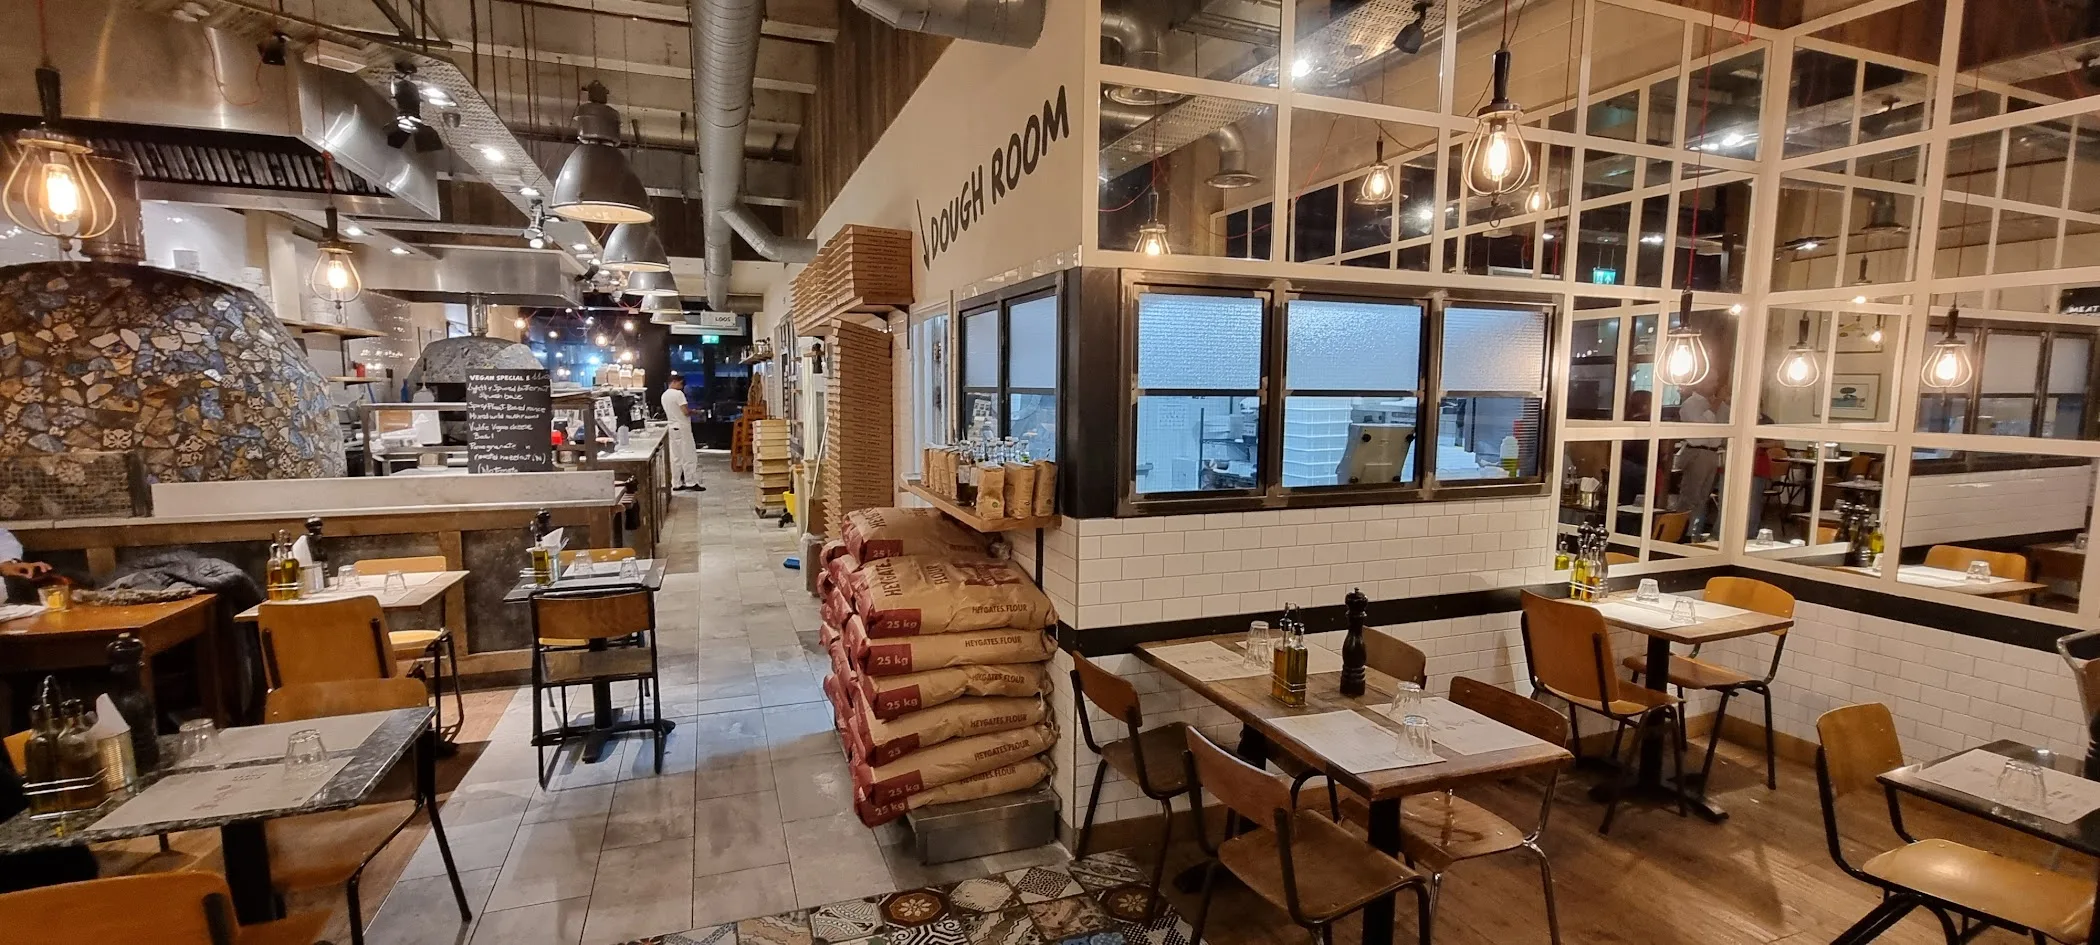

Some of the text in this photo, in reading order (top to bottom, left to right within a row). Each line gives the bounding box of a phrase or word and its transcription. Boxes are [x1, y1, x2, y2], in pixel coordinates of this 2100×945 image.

[931, 85, 1069, 260] DOUGH ROOM
[875, 558, 903, 597] HEYGATE
[926, 564, 950, 585] FLOUR
[886, 619, 918, 629] 25 kg
[877, 655, 909, 666] 25 kg
[886, 697, 918, 710] 25 kg
[888, 747, 901, 757] 25
[888, 783, 920, 797] 25 kg
[875, 802, 905, 816] 25 kg
